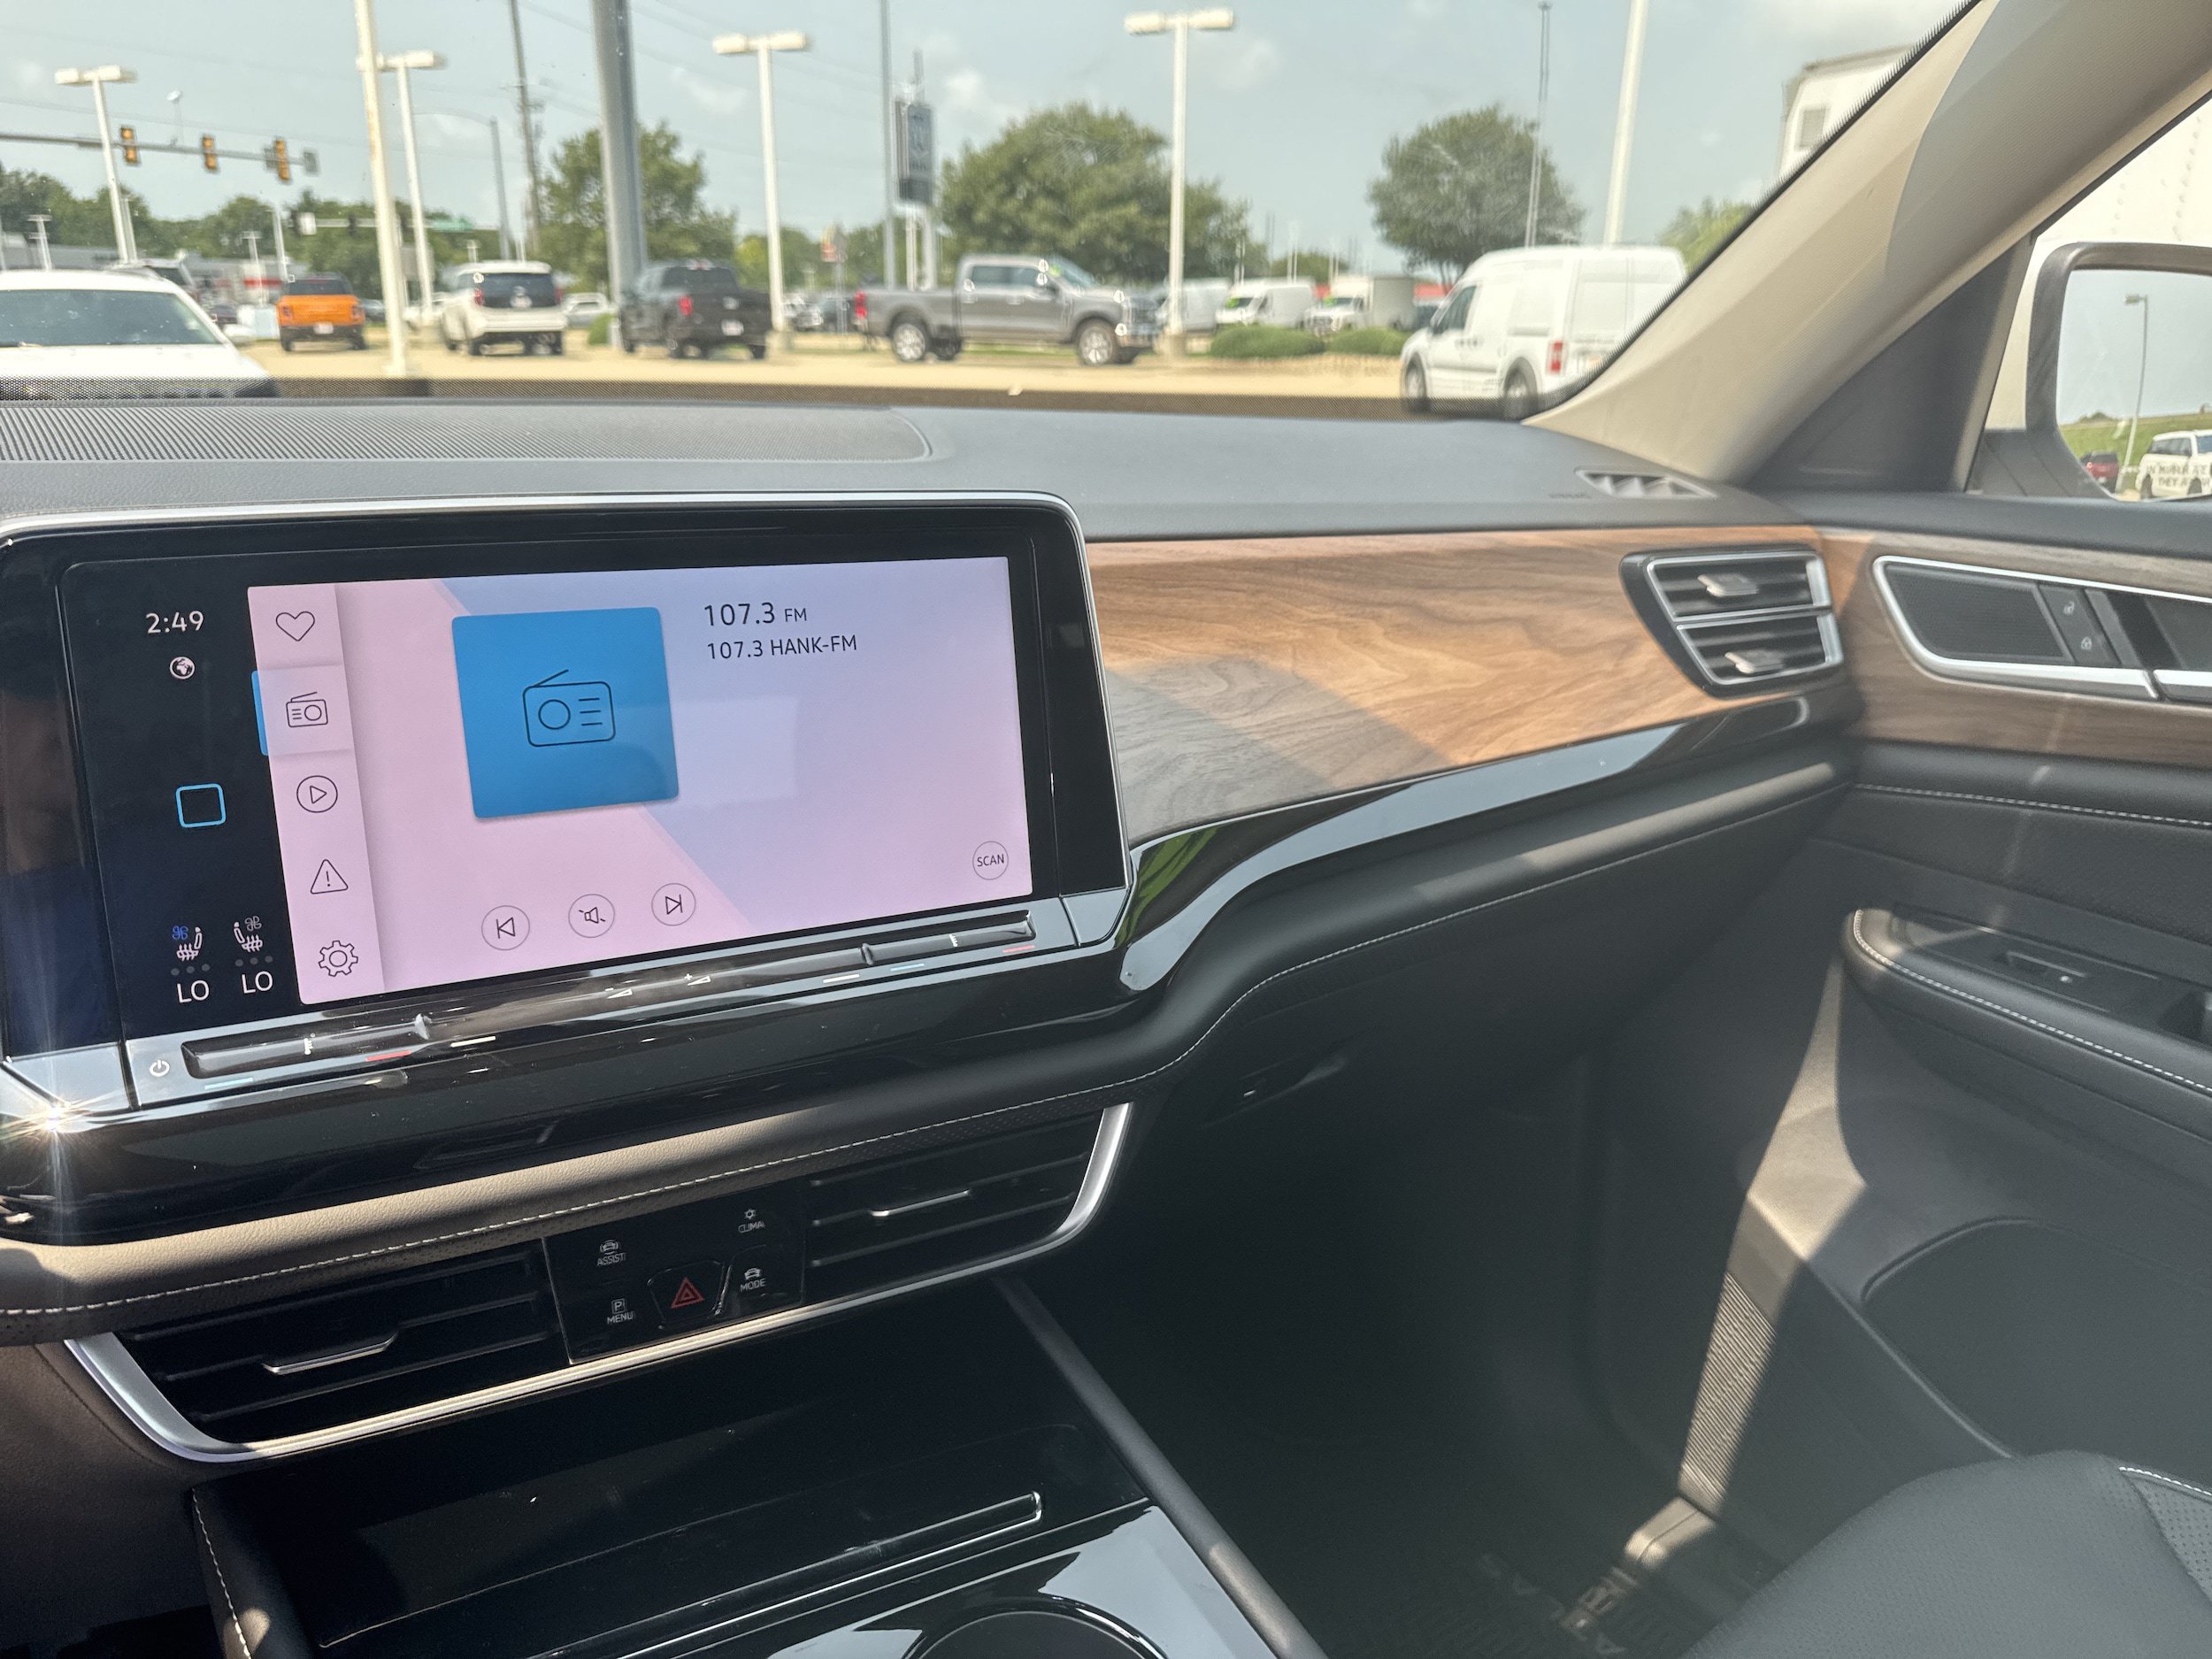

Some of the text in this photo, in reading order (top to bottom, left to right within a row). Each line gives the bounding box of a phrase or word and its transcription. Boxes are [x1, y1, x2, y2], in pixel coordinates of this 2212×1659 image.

[145, 611, 204, 634] 2:49
[704, 602, 808, 626] 107.3 FM
[707, 634, 858, 659] 107.3 HANK-FM
[977, 853, 1005, 867] SCAN
[177, 979, 210, 1003] LO
[241, 971, 273, 995] LO
[738, 1220, 765, 1233] CLIMA
[597, 1252, 626, 1266] ASSIST
[740, 1278, 766, 1293] MODE
[607, 1310, 634, 1325] MENU
